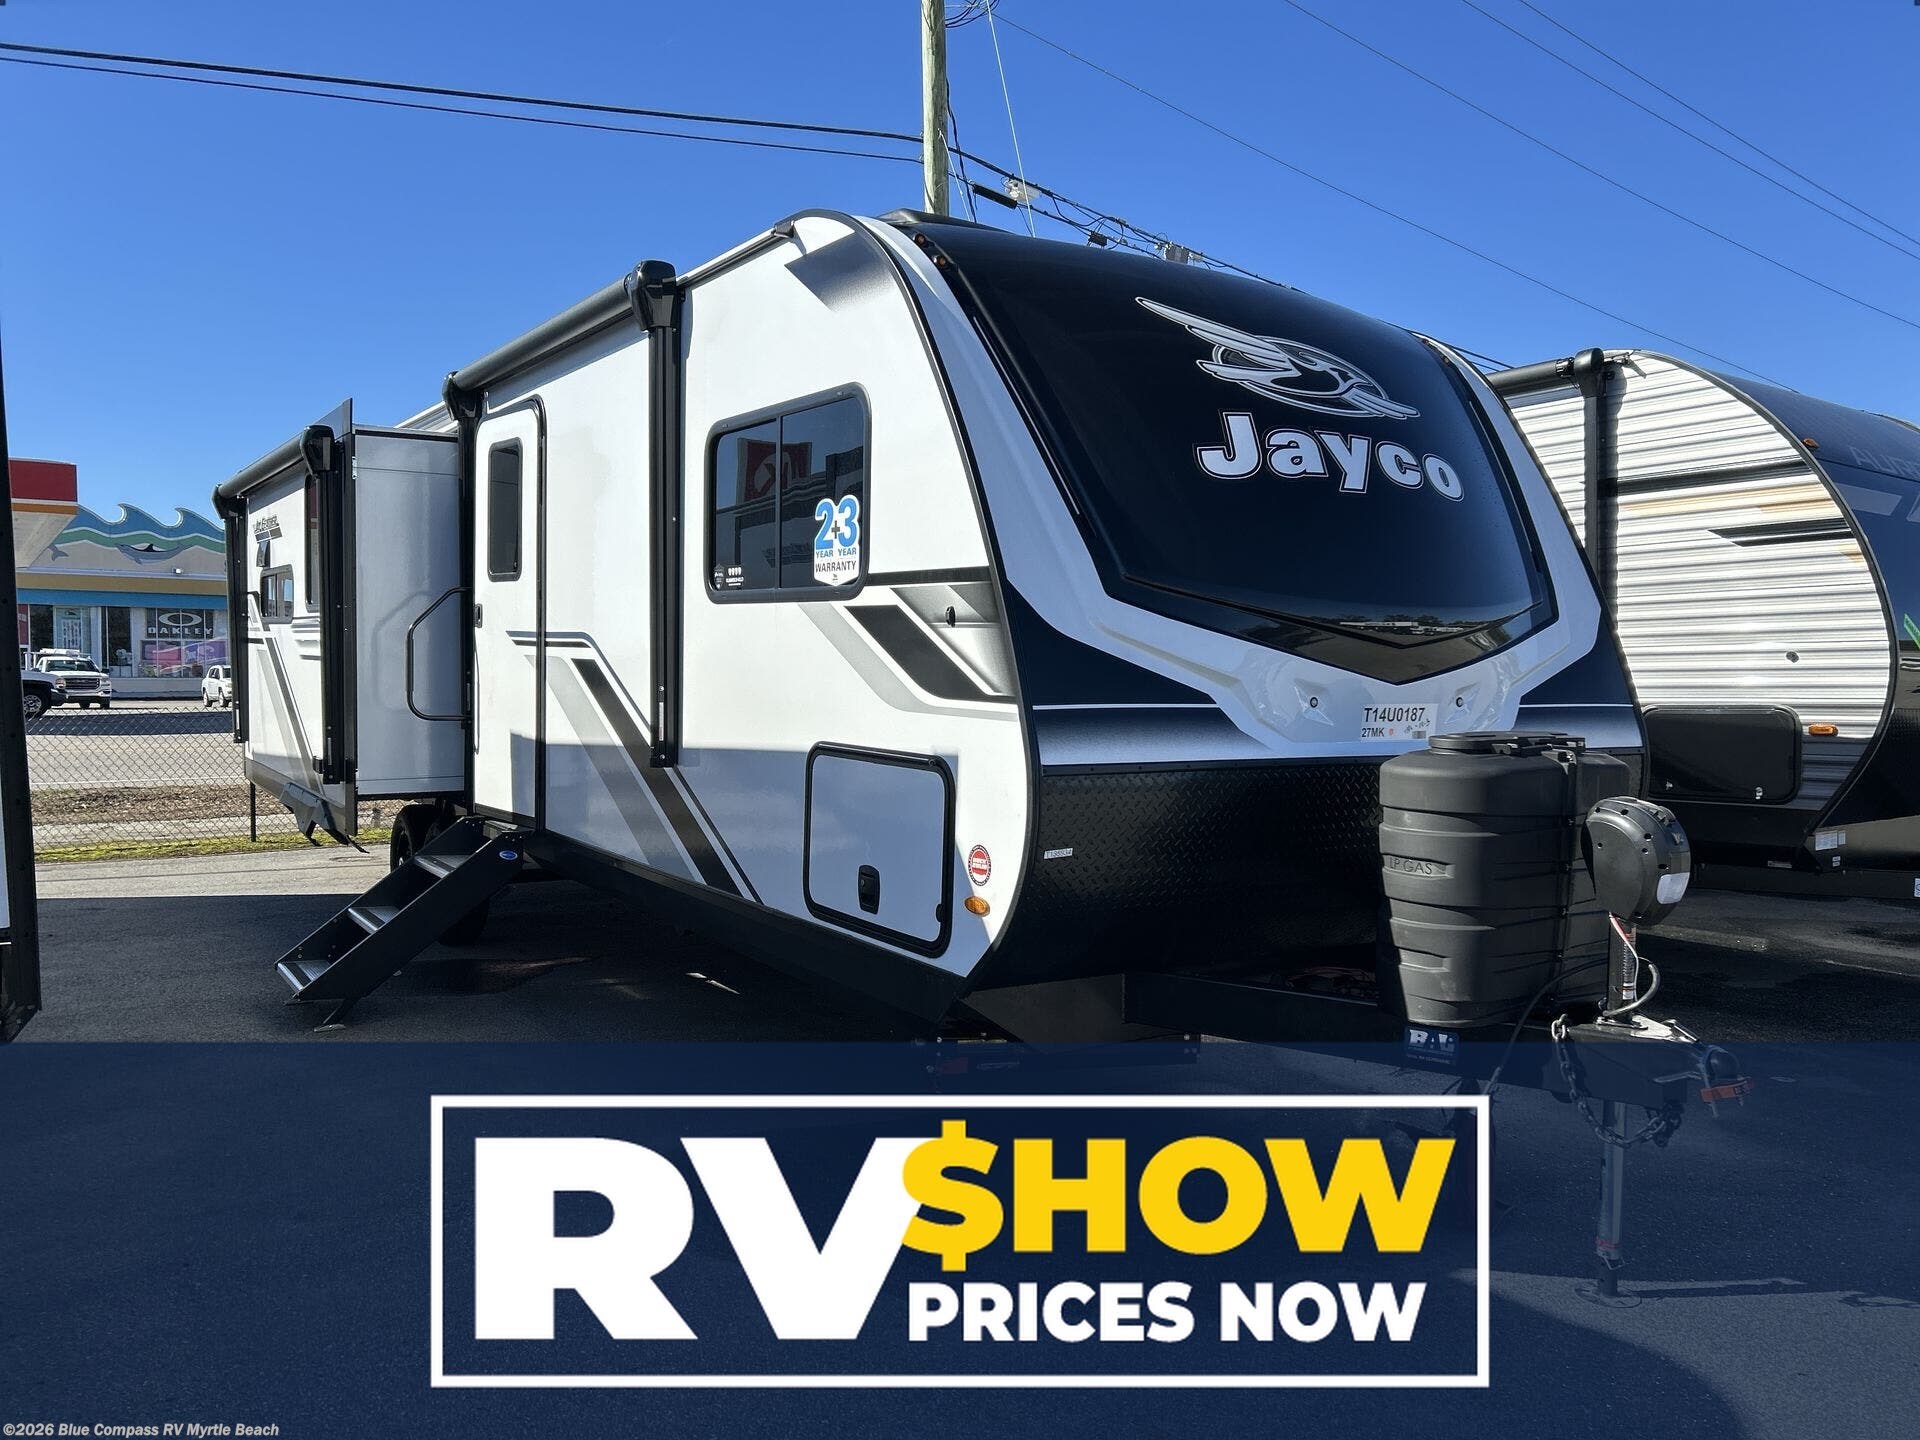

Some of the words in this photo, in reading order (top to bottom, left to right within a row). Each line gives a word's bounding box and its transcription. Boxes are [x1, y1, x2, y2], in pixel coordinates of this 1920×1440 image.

[1194, 409, 1464, 501] Jayco
[815, 549, 834, 559] YEAR
[837, 547, 857, 557] YEAR
[815, 560, 857, 573] WARRANTY
[147, 626, 213, 635] OAKLEY
[1364, 707, 1426, 722] T14U0187
[1361, 727, 1385, 738] 27MK
